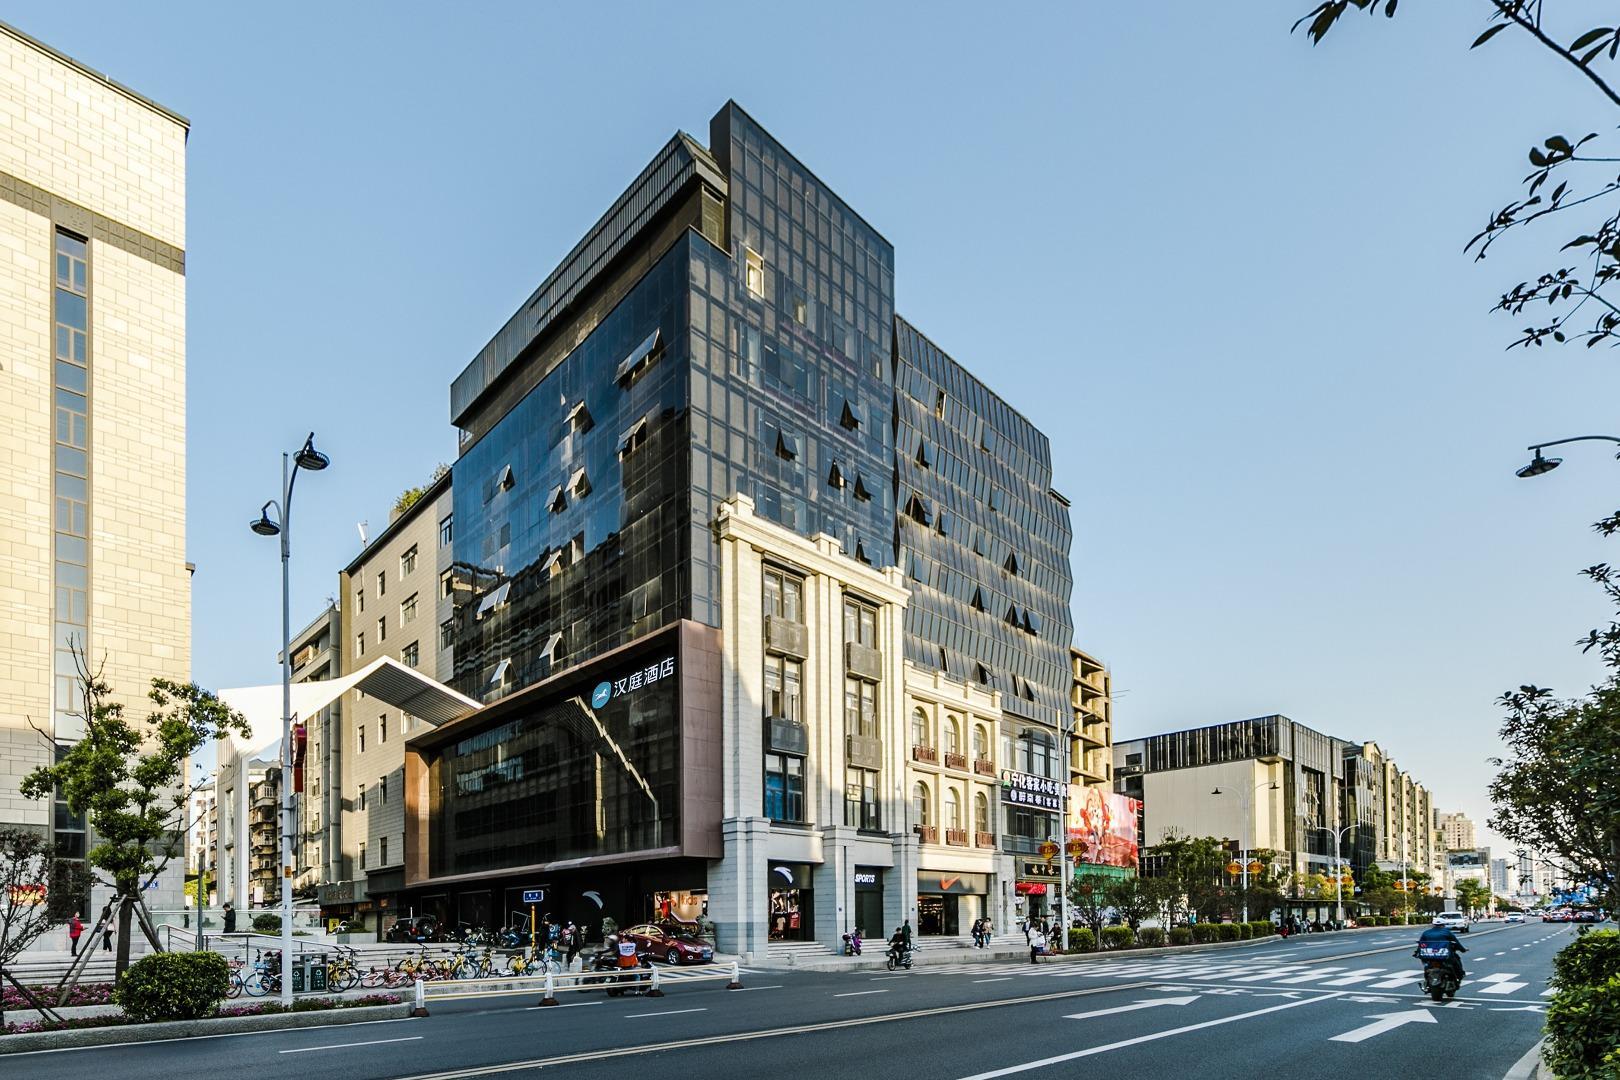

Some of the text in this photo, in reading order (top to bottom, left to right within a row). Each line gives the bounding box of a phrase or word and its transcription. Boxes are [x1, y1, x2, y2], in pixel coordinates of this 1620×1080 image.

[613, 656, 674, 698] 汉庭酒店
[855, 873, 876, 883] SPORTS
